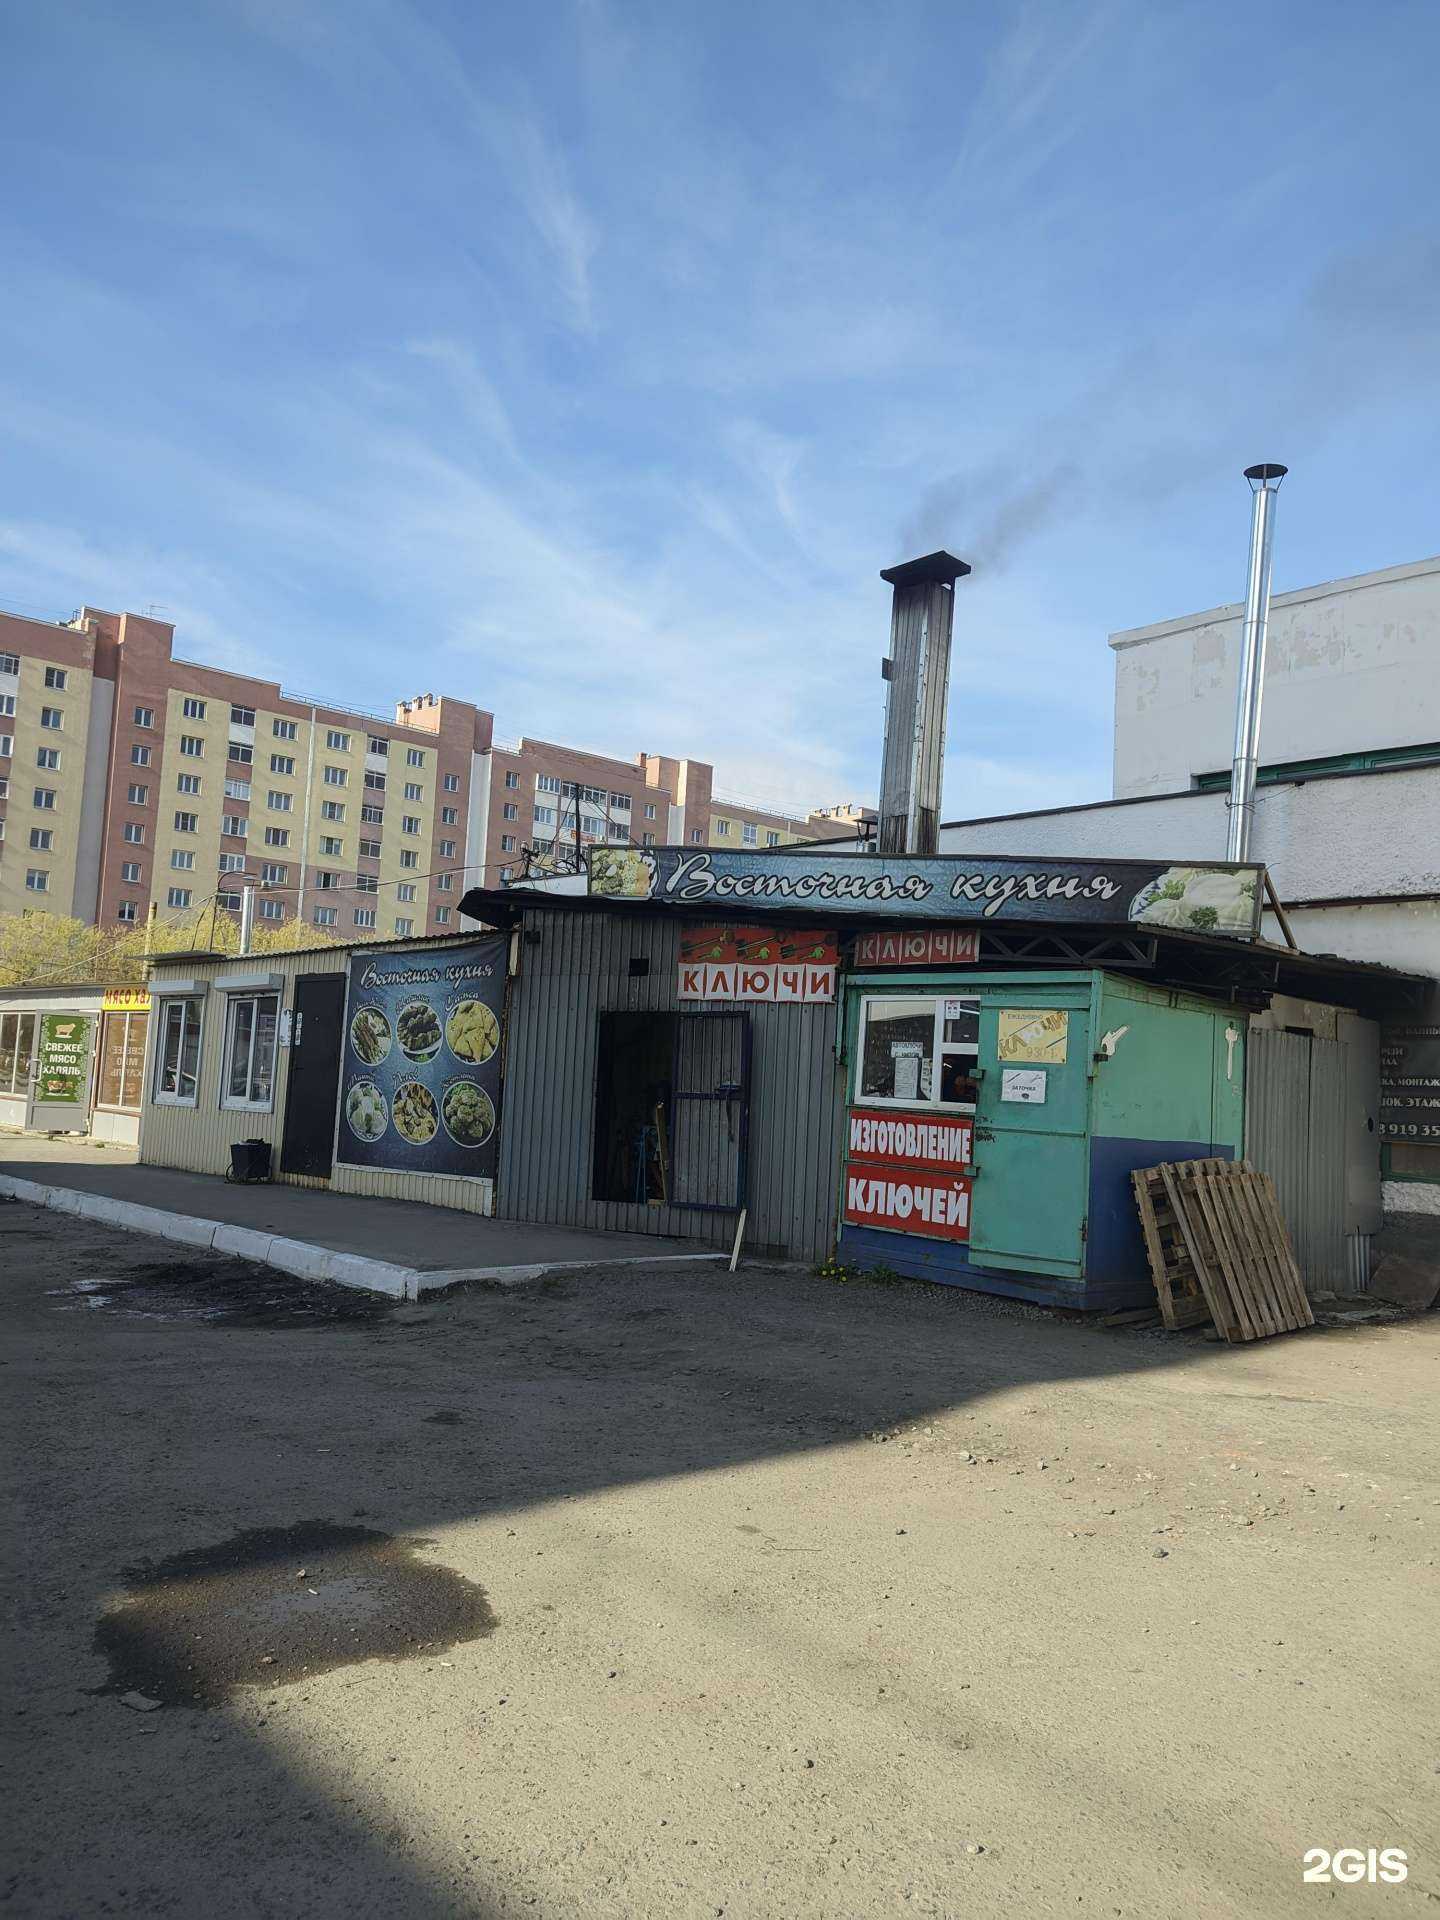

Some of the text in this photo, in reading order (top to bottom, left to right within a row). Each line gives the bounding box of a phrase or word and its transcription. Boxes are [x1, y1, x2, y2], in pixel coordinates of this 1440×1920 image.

[665, 853, 1123, 916] Восточная кухня
[862, 933, 972, 960] КЛЮЧИ
[360, 961, 494, 990] Восточная кухня
[683, 970, 830, 994] КЛЮЧИ
[45, 1042, 83, 1053] СВЕЖЕЕ
[49, 1054, 77, 1064] МЯСО
[43, 1065, 81, 1076] ХАЛЯЛЬ
[850, 1118, 971, 1164] ИЗГОТОВЛЕНИЕ
[1389, 1123, 1418, 1136] 919
[848, 1177, 969, 1228] КЛЮЧЕЙ
